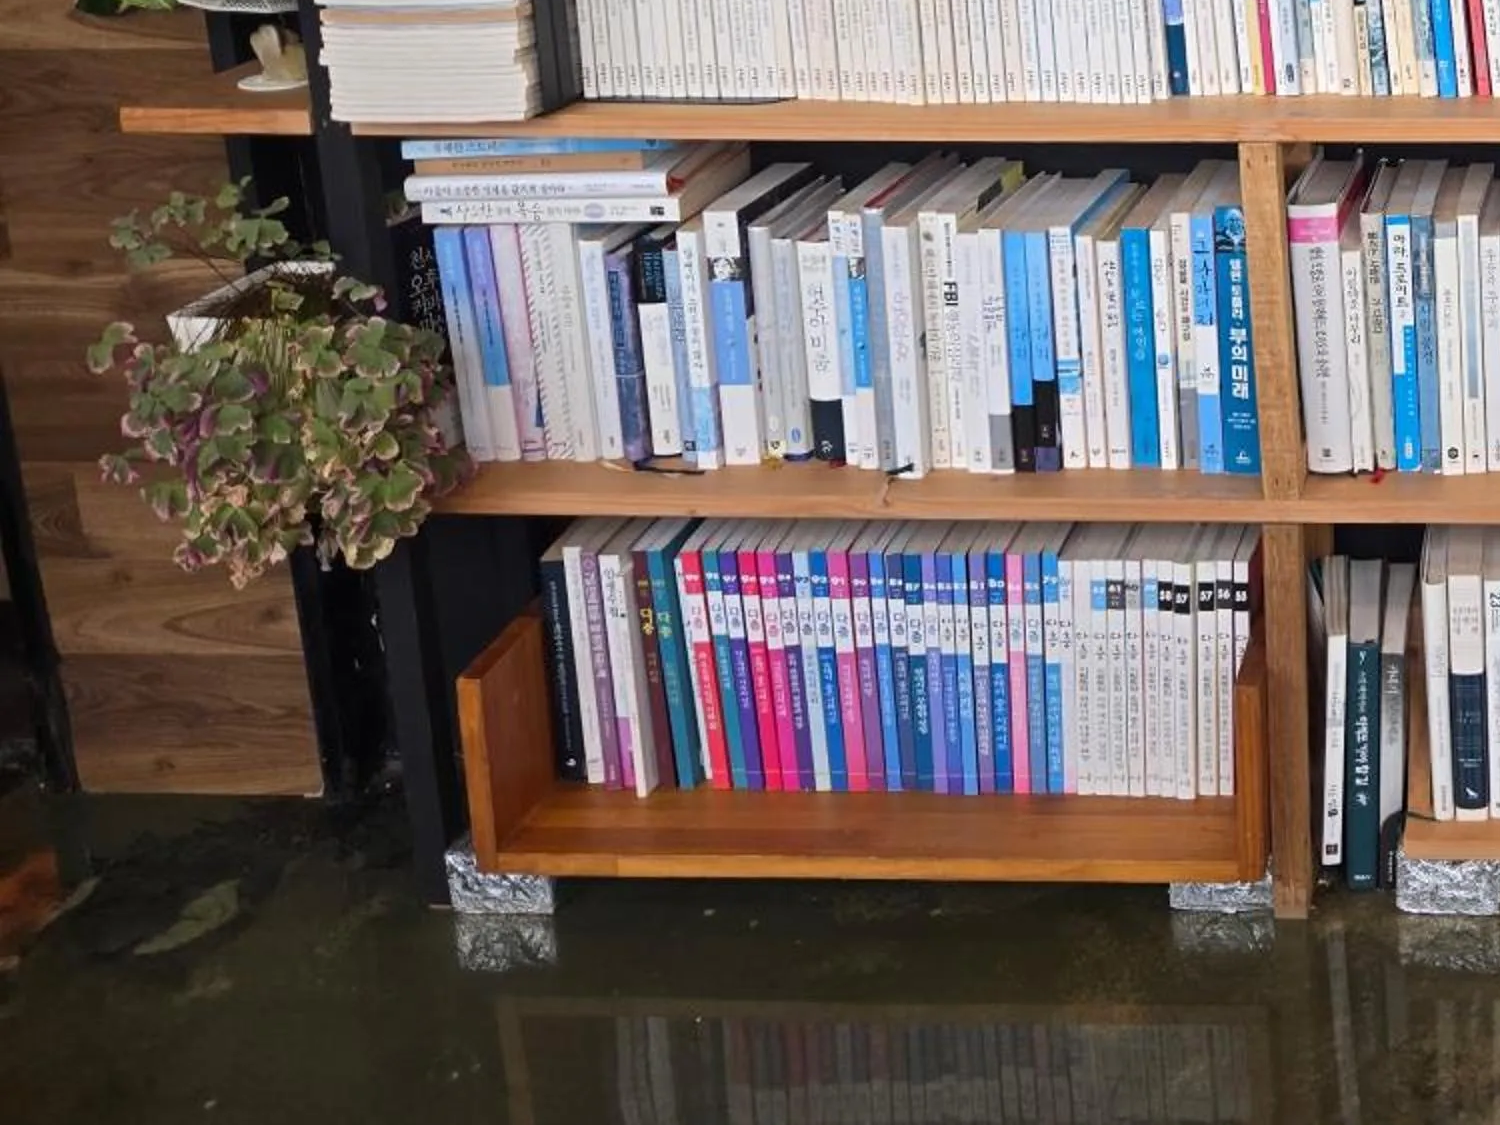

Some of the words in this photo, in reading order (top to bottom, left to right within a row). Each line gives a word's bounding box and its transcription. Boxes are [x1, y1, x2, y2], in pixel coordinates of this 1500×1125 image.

[1367, 232, 1379, 257] 끌리는
[1368, 260, 1380, 284] 사람은
[943, 281, 958, 306] FBI
[1230, 327, 1247, 362] 부의
[1231, 365, 1249, 400] 미래
[831, 577, 845, 585] 91
[905, 582, 920, 591] 87
[1159, 589, 1172, 601] 58
[1175, 593, 1188, 604] 57
[1199, 589, 1213, 601] 57
[1217, 588, 1231, 599] 56
[1235, 590, 1247, 602] 55
